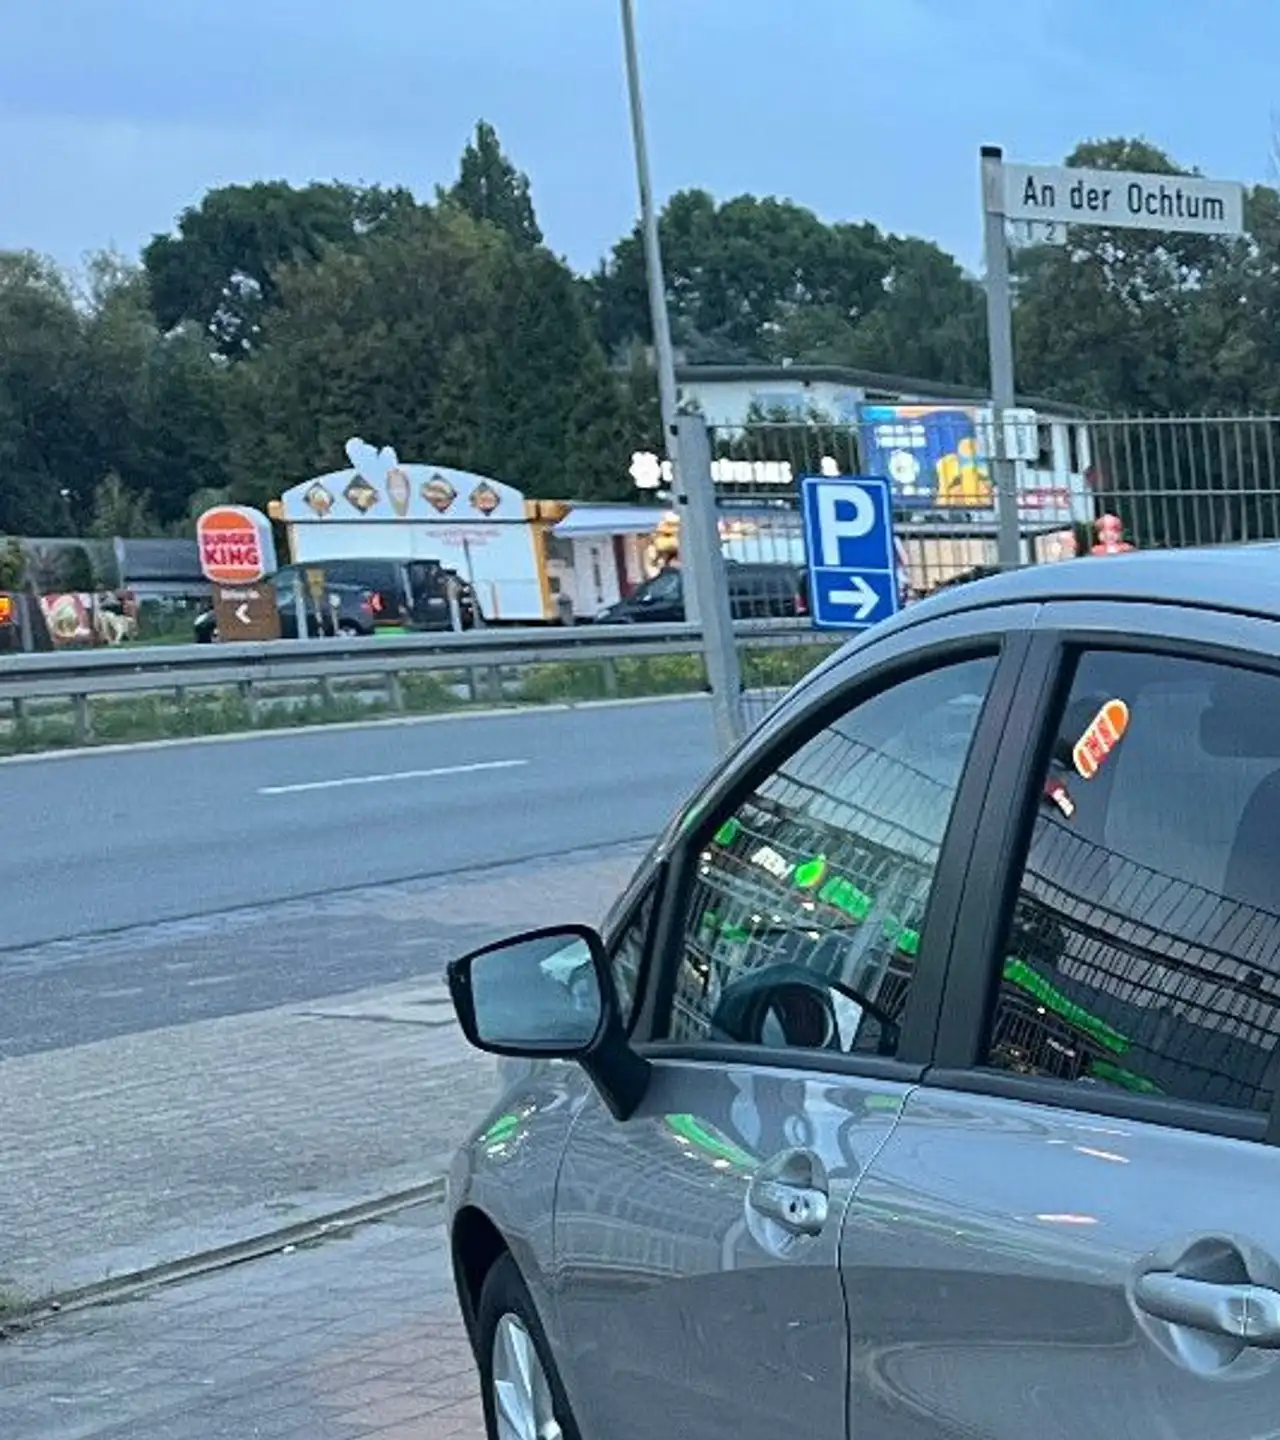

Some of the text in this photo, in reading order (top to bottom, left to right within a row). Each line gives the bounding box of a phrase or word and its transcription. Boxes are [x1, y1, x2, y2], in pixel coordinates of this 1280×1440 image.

[1023, 175, 1225, 220] An der Ochtum
[816, 484, 876, 566] P
[204, 547, 259, 566] KING
